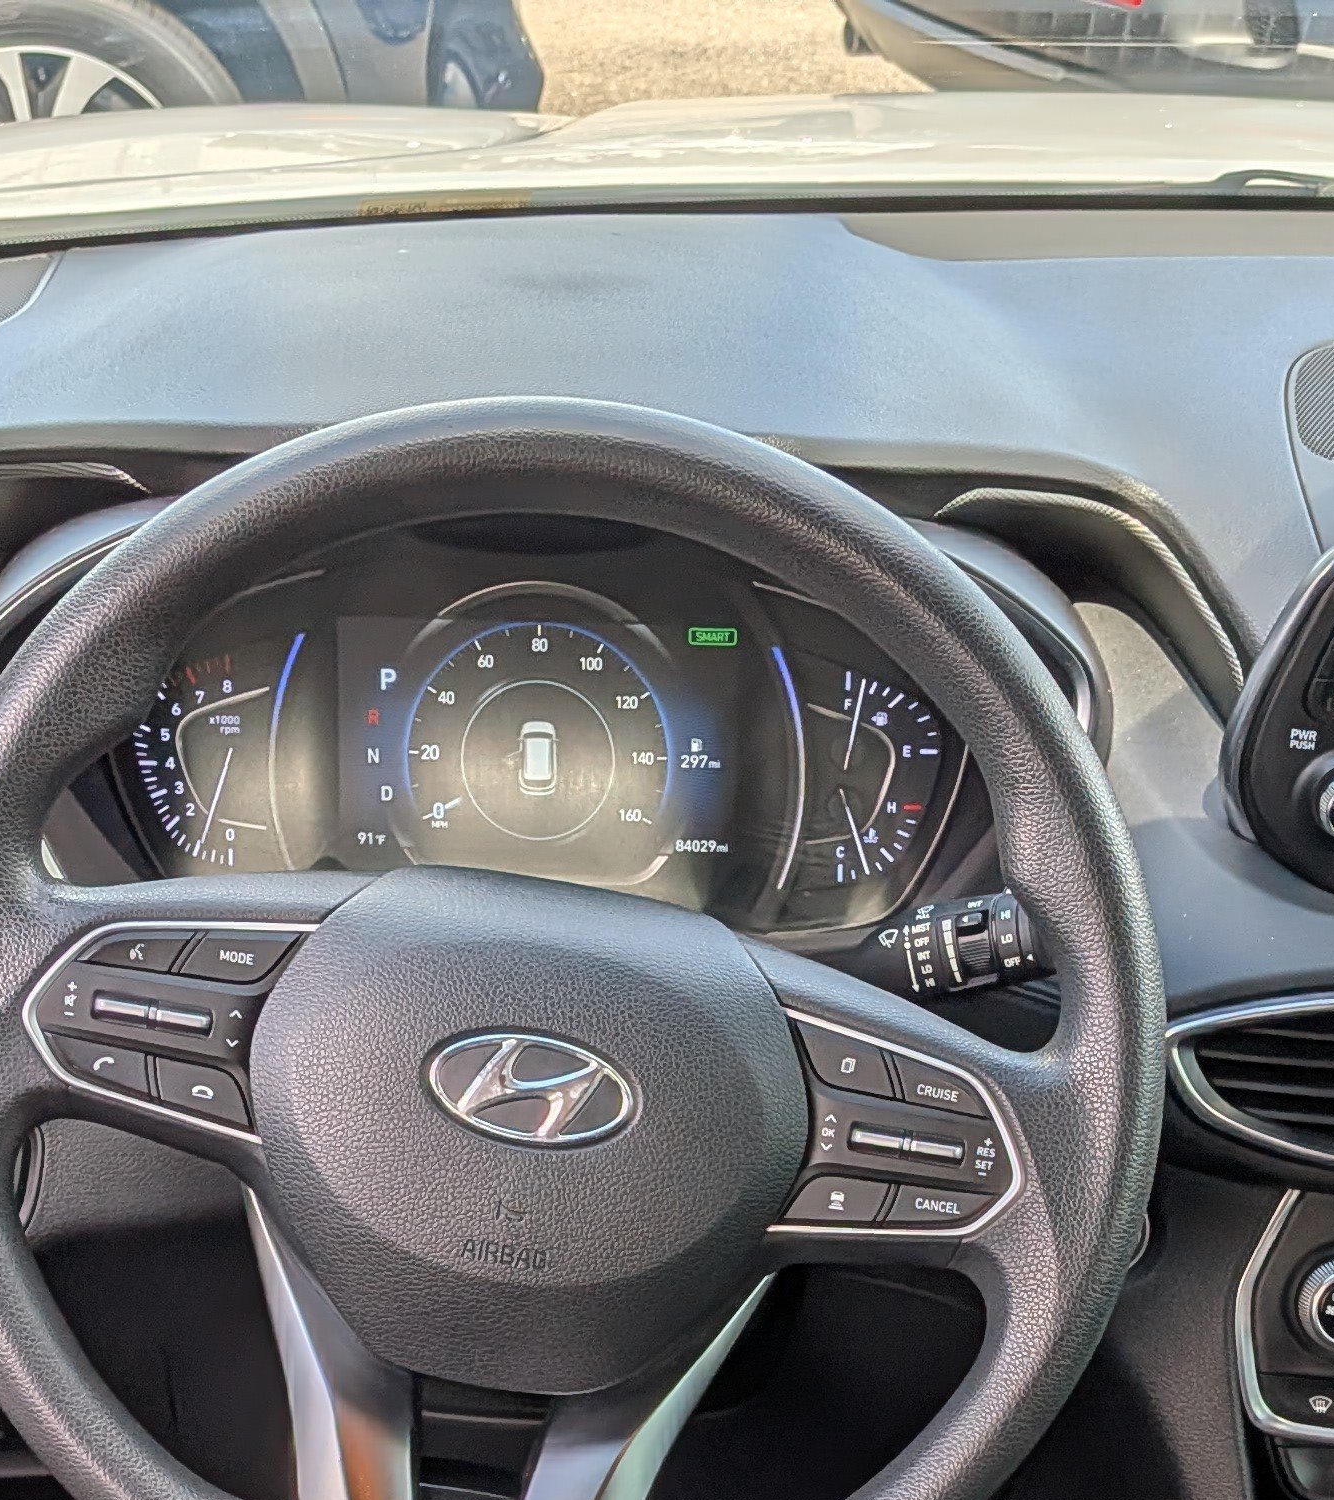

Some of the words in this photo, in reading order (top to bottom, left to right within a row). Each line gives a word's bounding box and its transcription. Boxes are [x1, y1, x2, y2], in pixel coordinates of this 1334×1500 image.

[695, 631, 730, 643] SMART
[531, 638, 549, 652] 80
[477, 654, 494, 668] 60
[579, 657, 603, 671] 100
[380, 668, 397, 691] P
[222, 679, 232, 694] 8
[195, 690, 205, 703] 7
[438, 691, 455, 705] 40
[616, 696, 639, 710] 120
[171, 703, 182, 716] 6
[844, 698, 852, 711] F
[160, 728, 170, 742] 5
[220, 725, 241, 736] rpm
[1290, 728, 1317, 742] PWR
[1289, 739, 1316, 750] PUSH
[367, 748, 380, 764] N
[420, 744, 440, 761] 20
[902, 745, 912, 758] E
[165, 756, 176, 770] 4
[632, 752, 654, 765] 140
[174, 781, 184, 795] 3
[381, 785, 393, 801] D
[185, 803, 195, 816] 2
[433, 802, 445, 819] 0
[887, 801, 897, 814] H
[619, 809, 642, 822] 160
[225, 828, 235, 841] 0
[836, 845, 845, 859] C
[1000, 909, 1011, 920] HI
[911, 922, 931, 935] MIST
[914, 937, 930, 948] OFF
[1001, 933, 1014, 944] LO
[219, 949, 255, 966] MODE
[917, 951, 931, 962] INT
[1004, 956, 1021, 968] OFF
[921, 964, 933, 975] LO
[925, 977, 936, 988] HI
[916, 1083, 960, 1103] CRUISE
[821, 1128, 836, 1138] OK
[976, 1146, 996, 1158] RES
[974, 1160, 993, 1171] SET
[915, 1197, 961, 1215] CANCEL
[461, 1239, 547, 1270] AIRBAG
